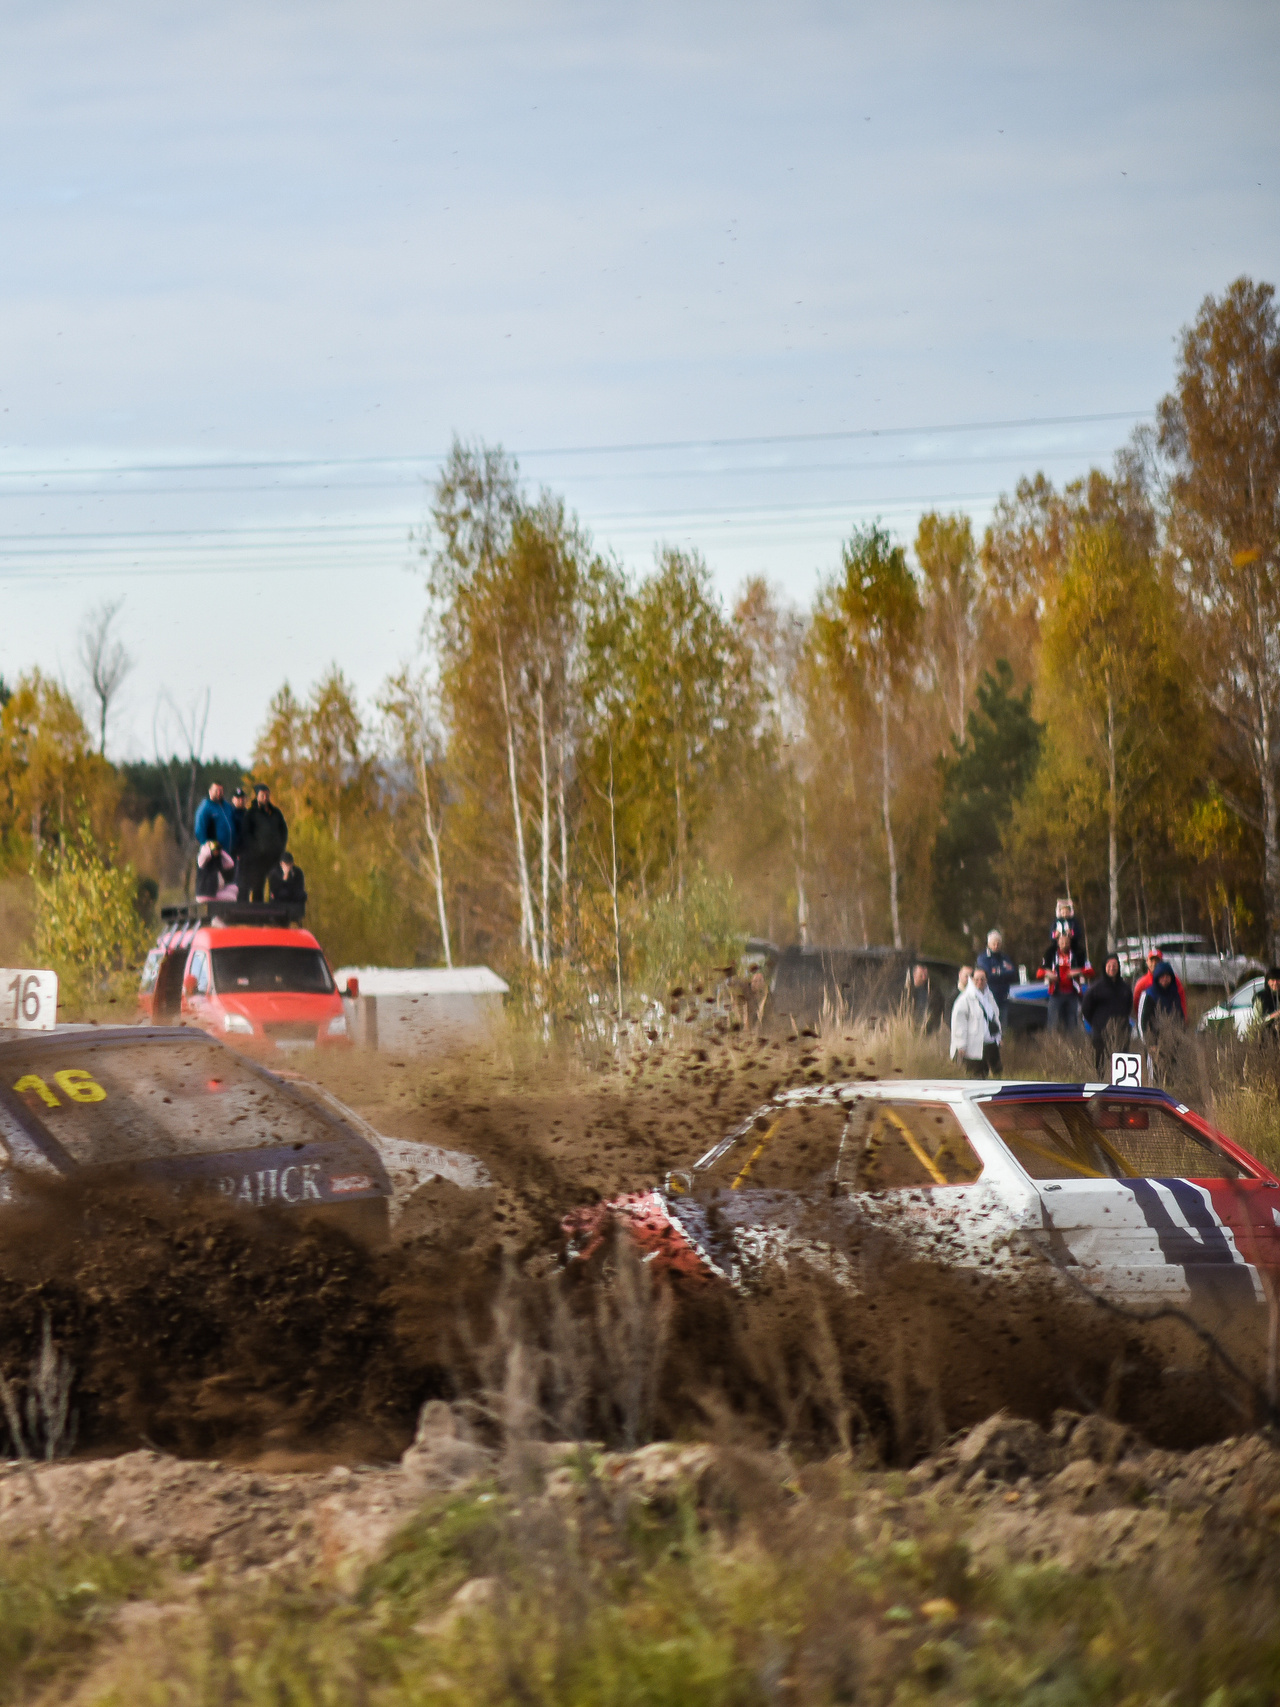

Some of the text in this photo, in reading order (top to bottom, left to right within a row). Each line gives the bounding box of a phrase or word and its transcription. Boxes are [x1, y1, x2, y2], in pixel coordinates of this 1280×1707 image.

[7, 973, 41, 1022] 16
[12, 1068, 108, 1108] 16
[1115, 1056, 1140, 1087] 23
[200, 1163, 323, 1208] РАНСК
